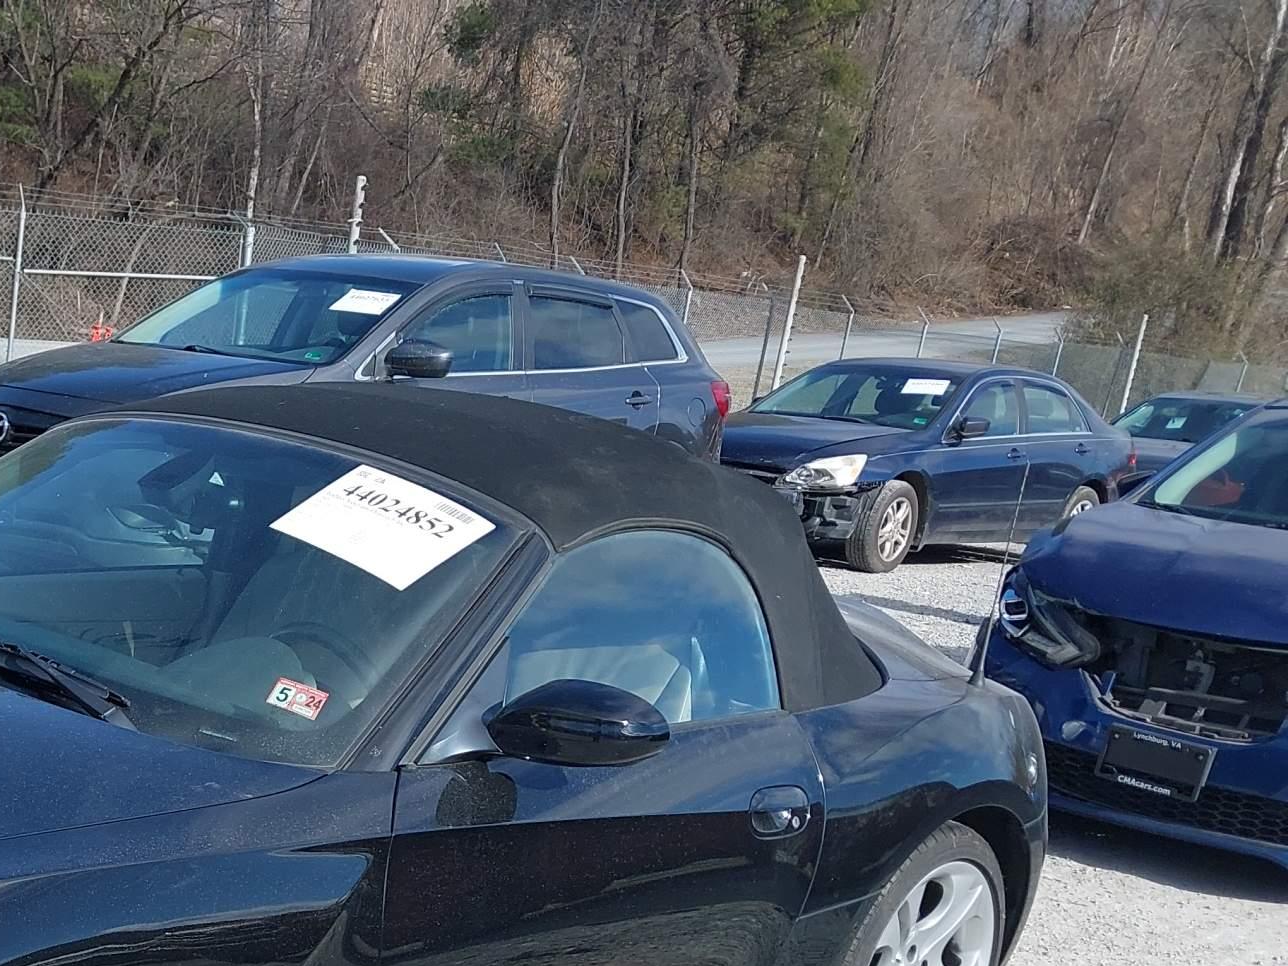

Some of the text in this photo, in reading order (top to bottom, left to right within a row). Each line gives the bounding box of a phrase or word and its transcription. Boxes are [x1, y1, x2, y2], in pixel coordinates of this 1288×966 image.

[342, 484, 456, 540] 44024852
[275, 686, 292, 703] 5
[305, 695, 324, 711] 24
[1171, 740, 1182, 750] VA
